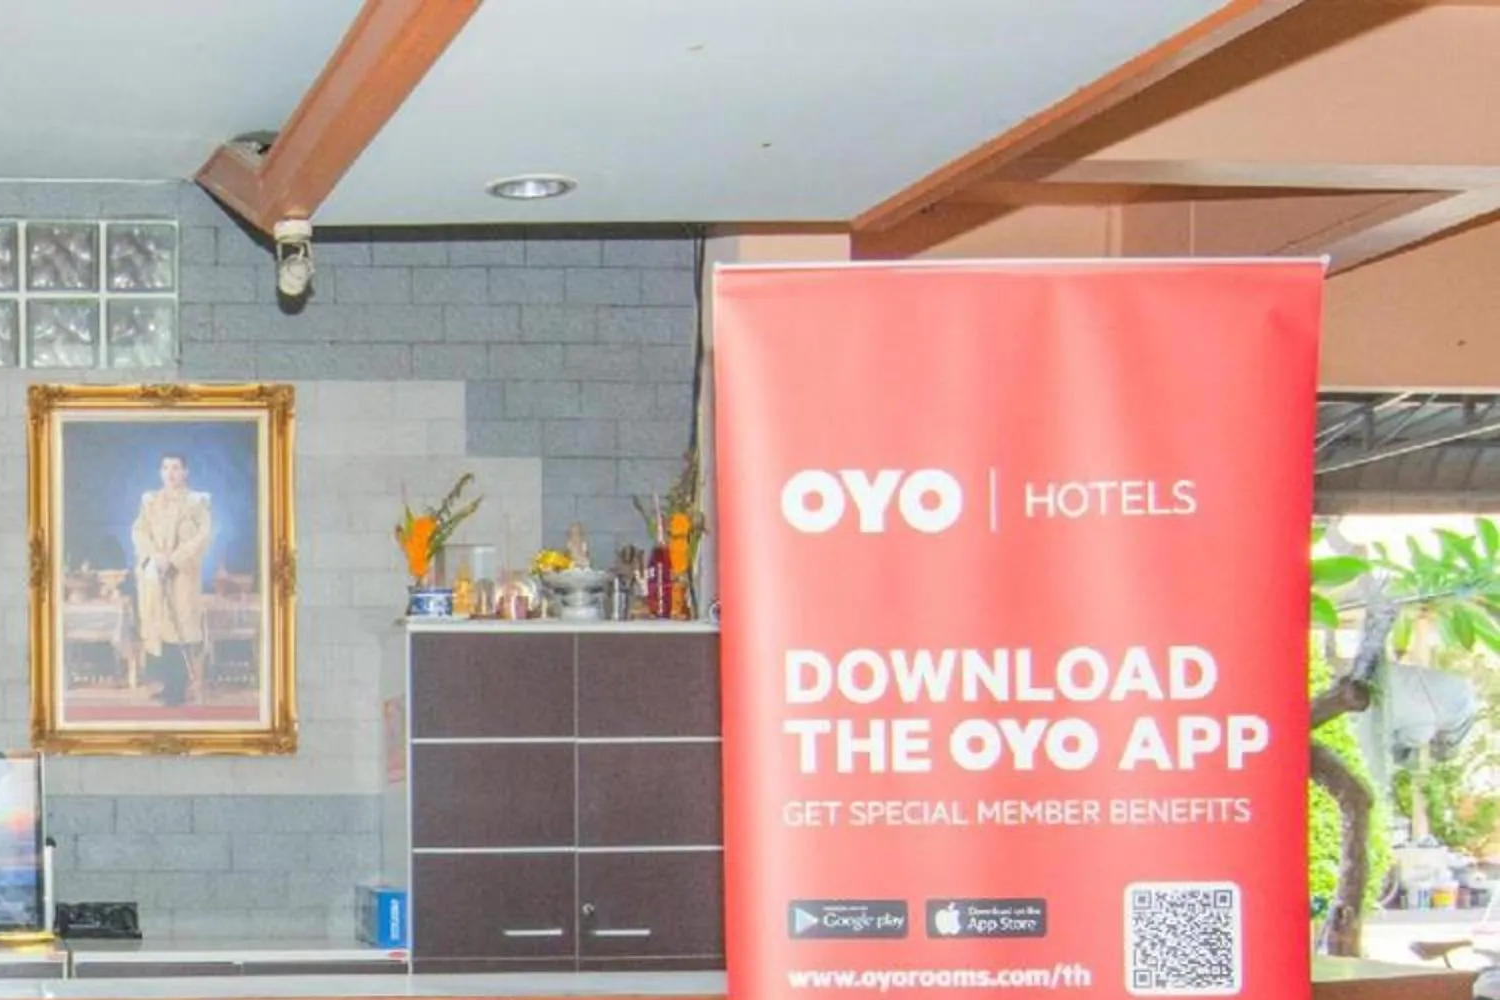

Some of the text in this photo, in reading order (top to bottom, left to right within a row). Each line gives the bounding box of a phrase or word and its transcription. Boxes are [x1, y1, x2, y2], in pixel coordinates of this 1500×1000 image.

[781, 468, 1197, 533] OYO HOTELS
[784, 646, 1217, 704] DOWNLOAD
[782, 715, 1269, 773] THE OYO APP
[782, 798, 1251, 826] GET SPECIAL MEMBER BENEFITS
[822, 912, 872, 931] Google
[967, 917, 1036, 933] App Store
[788, 962, 1092, 991] www.oyorooms.com/th
